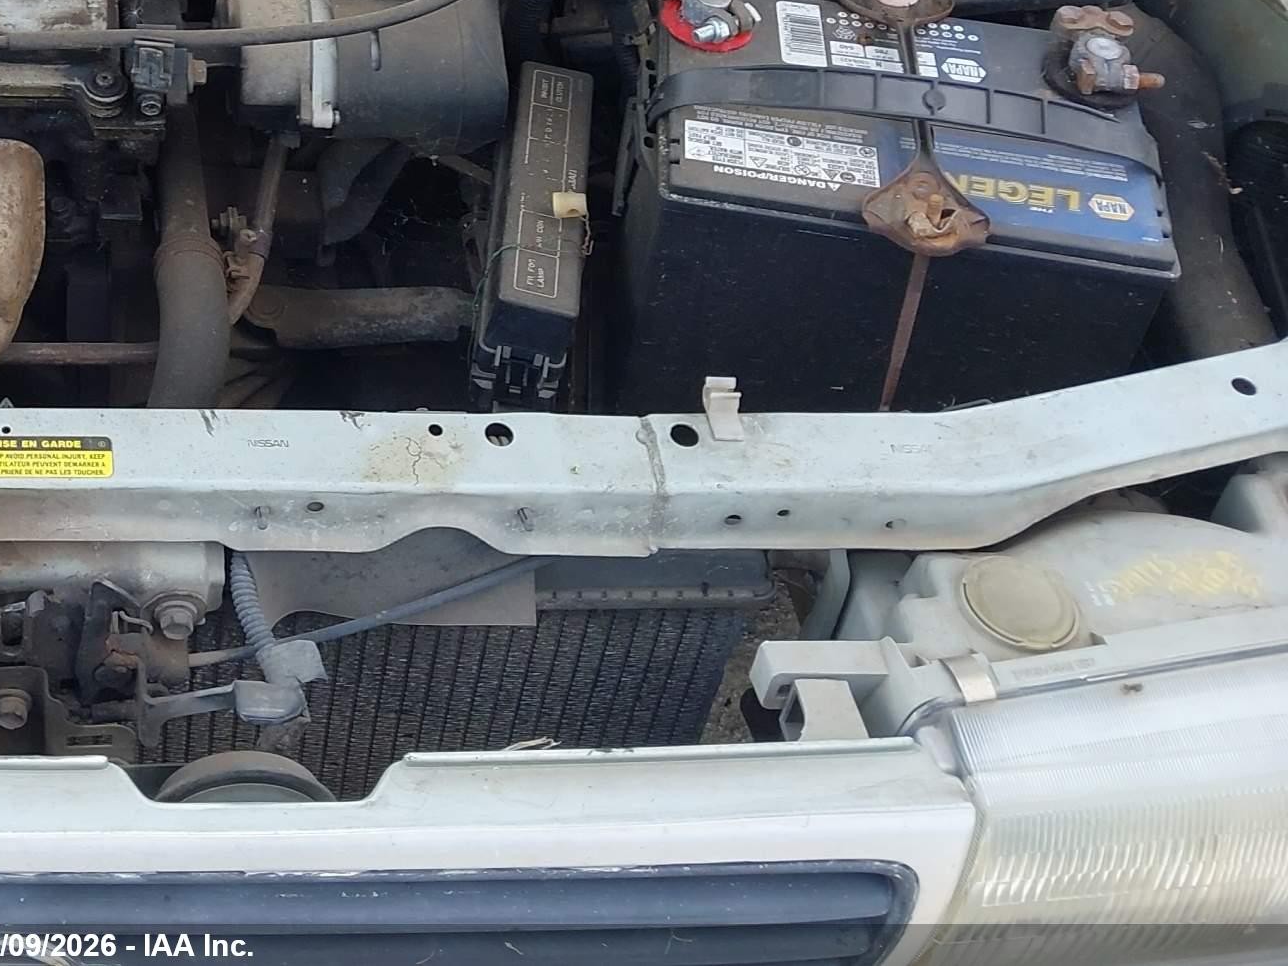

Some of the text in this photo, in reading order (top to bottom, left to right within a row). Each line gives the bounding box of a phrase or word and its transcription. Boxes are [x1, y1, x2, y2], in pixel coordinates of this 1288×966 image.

[947, 62, 979, 79] NAPA
[713, 164, 827, 190] DANGER/POISON
[1095, 199, 1129, 216] NAPA
[21, 439, 37, 449] EN
[41, 439, 82, 449] GARDE
[247, 439, 289, 448] NISSAN
